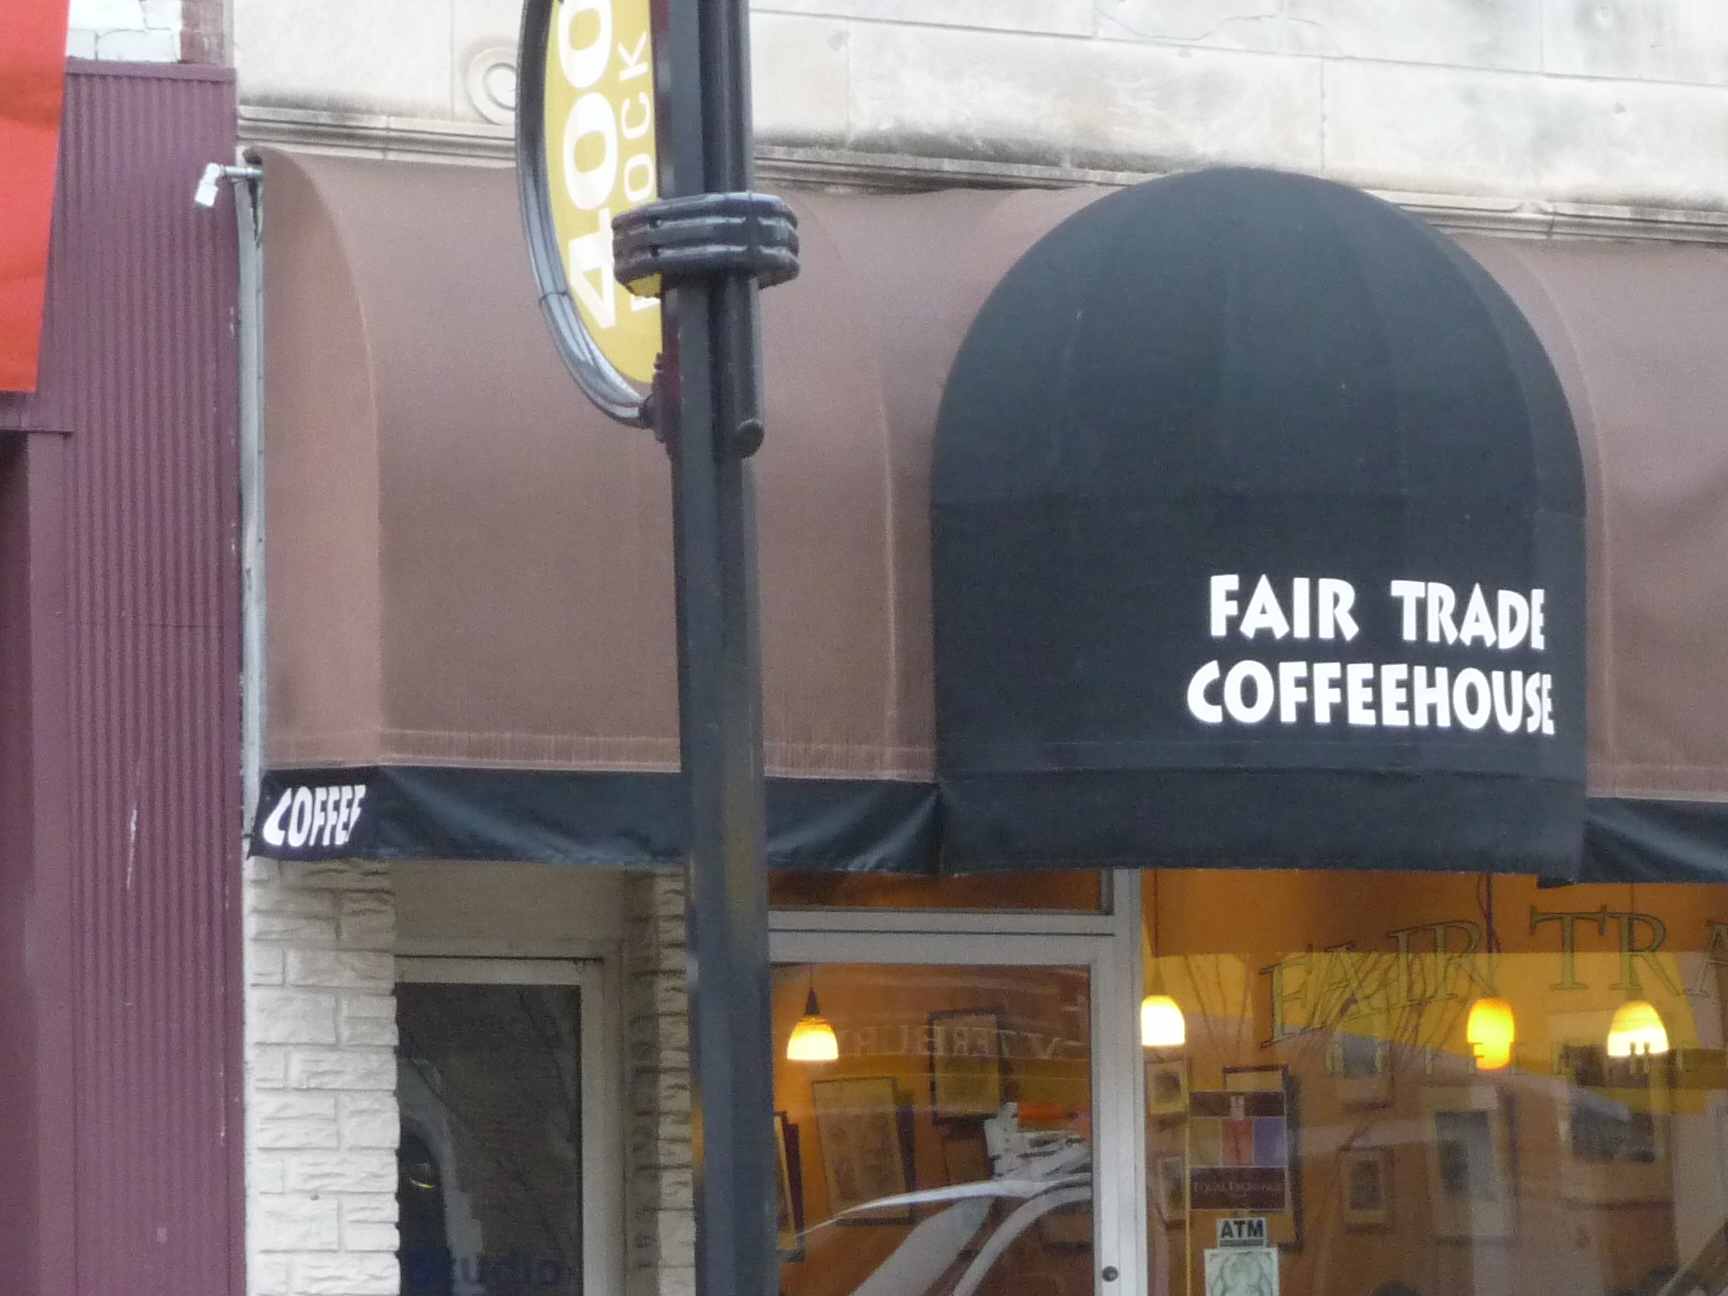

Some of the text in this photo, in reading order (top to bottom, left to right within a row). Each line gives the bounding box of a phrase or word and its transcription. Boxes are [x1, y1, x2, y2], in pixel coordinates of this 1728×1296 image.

[1209, 573, 1545, 651] FAIR TRADE
[1186, 659, 1555, 735] COFFEEHOUSE
[262, 784, 367, 847] COFFEE
[1220, 1219, 1265, 1239] ATM
